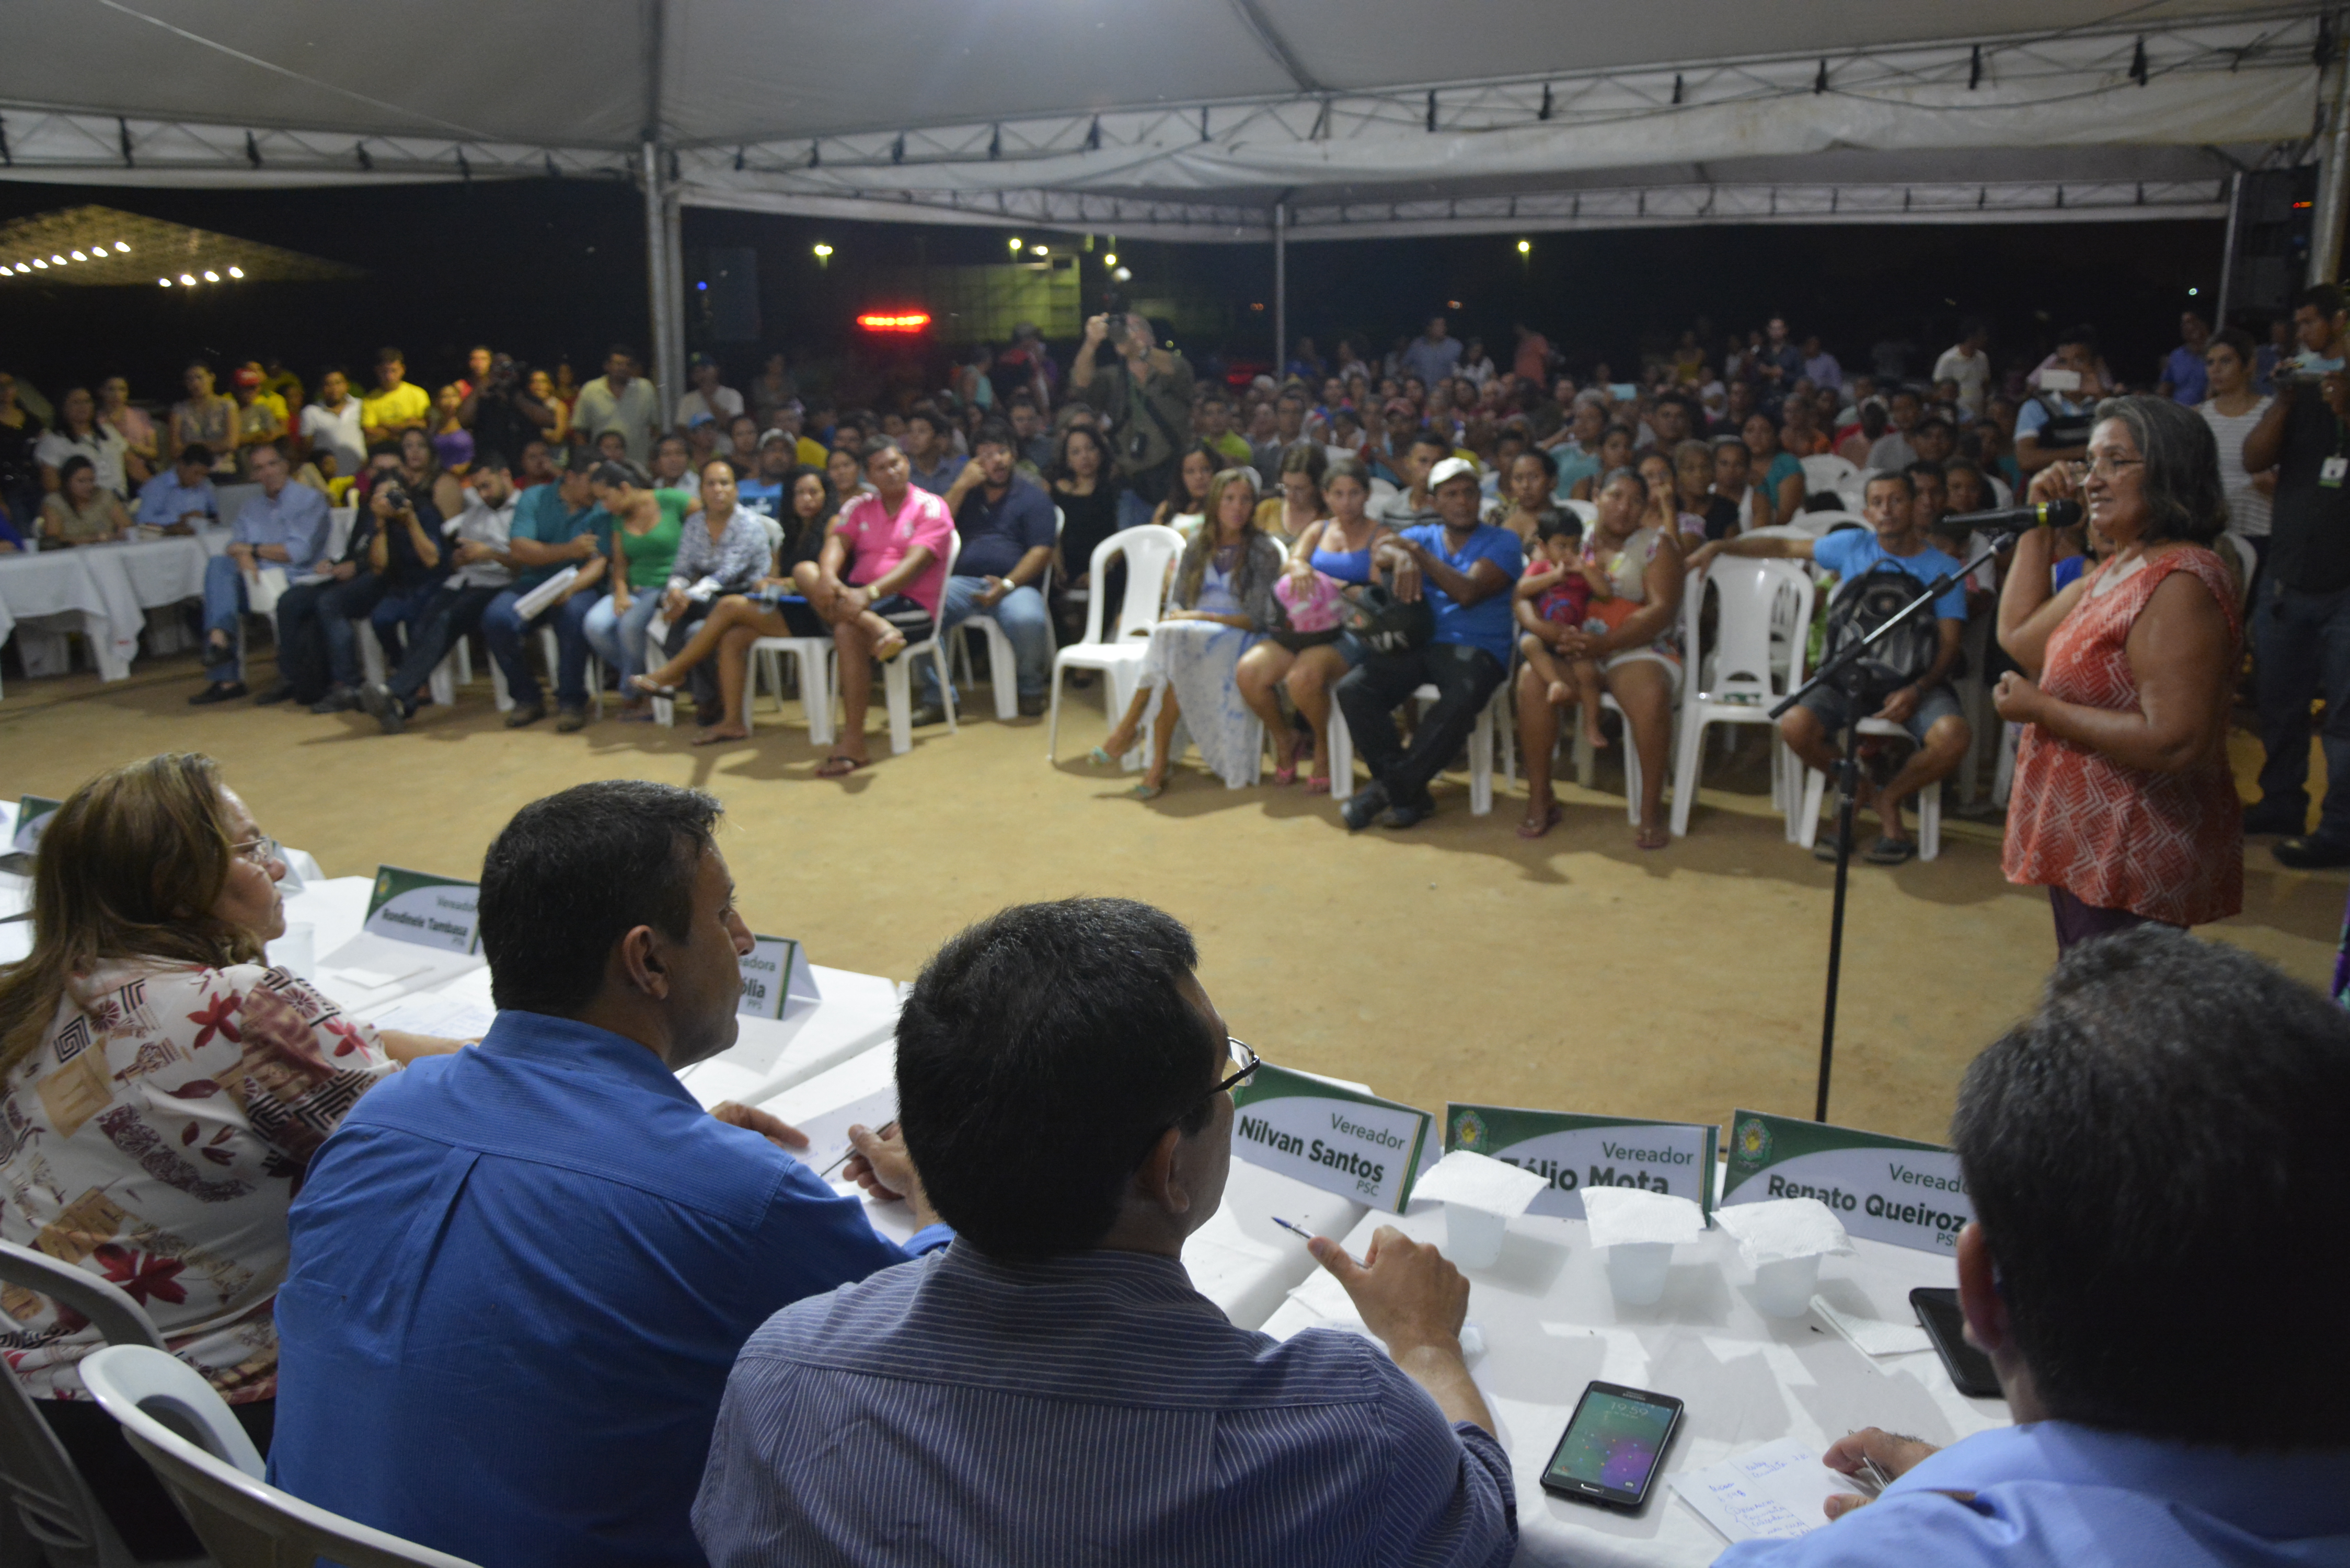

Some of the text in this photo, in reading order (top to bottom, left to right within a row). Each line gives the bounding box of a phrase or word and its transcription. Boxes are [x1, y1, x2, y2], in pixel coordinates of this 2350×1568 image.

[1332, 1113, 1406, 1150] Vereador
[1238, 1115, 1385, 1182] Nilvan Santos
[1603, 1142, 1694, 1166] Vereador
[1356, 1180, 1379, 1197] PSC
[1589, 1165, 1669, 1195] Mota
[1768, 1174, 1967, 1232] Renato Queiroz
[1937, 1232, 1957, 1247] PS
